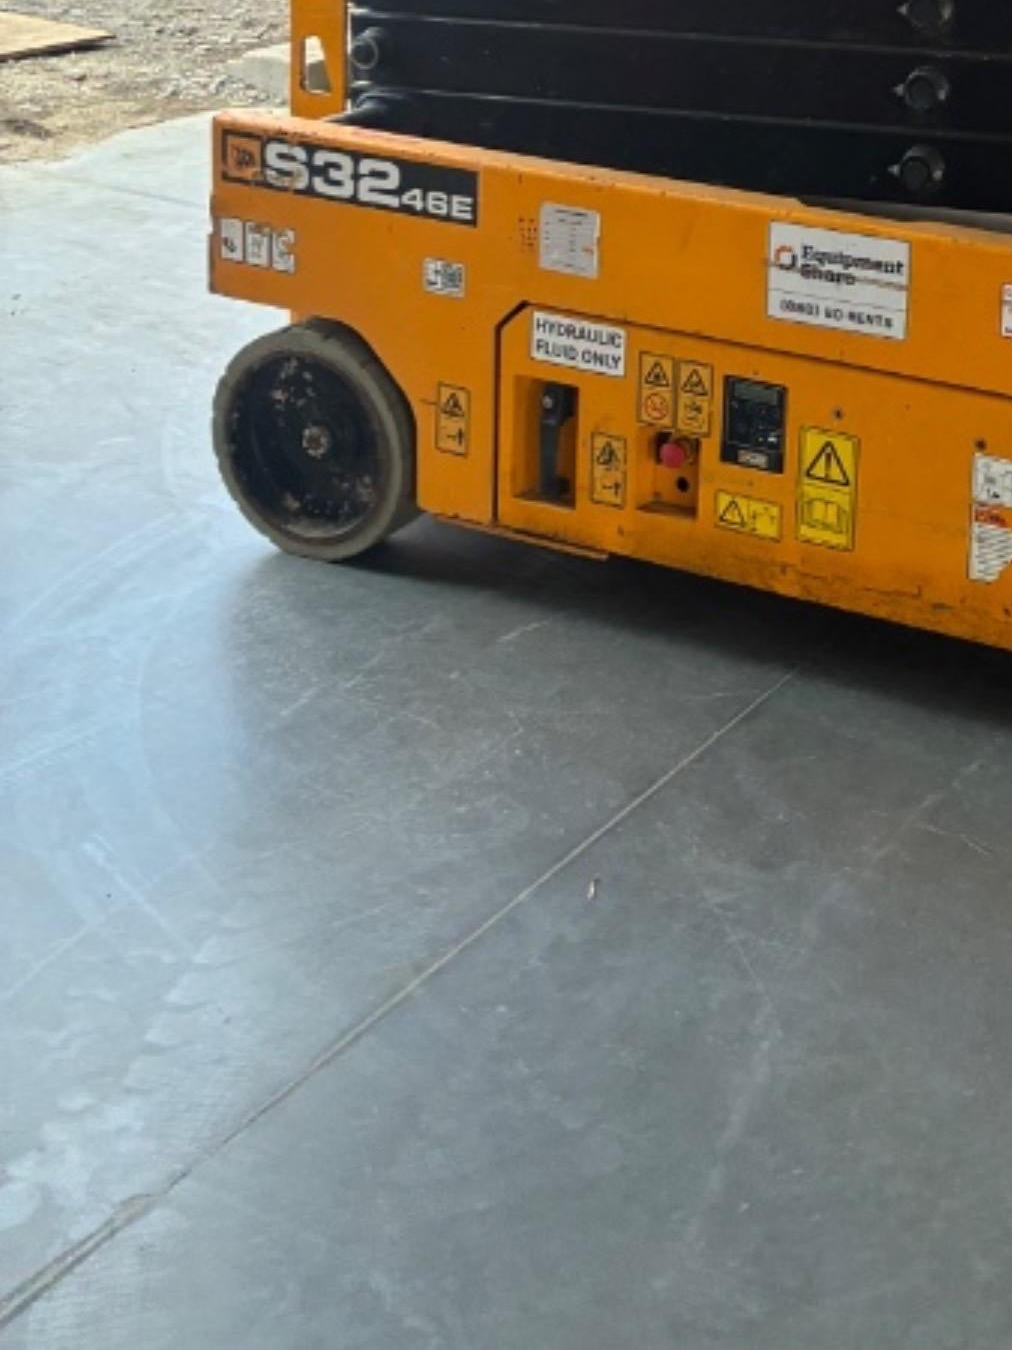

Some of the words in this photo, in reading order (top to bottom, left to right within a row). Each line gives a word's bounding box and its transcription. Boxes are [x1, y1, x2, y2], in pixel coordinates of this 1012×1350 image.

[536, 317, 622, 348] HYDRAULIC
[536, 339, 578, 360] FLUID
[581, 349, 621, 369] ONLY
